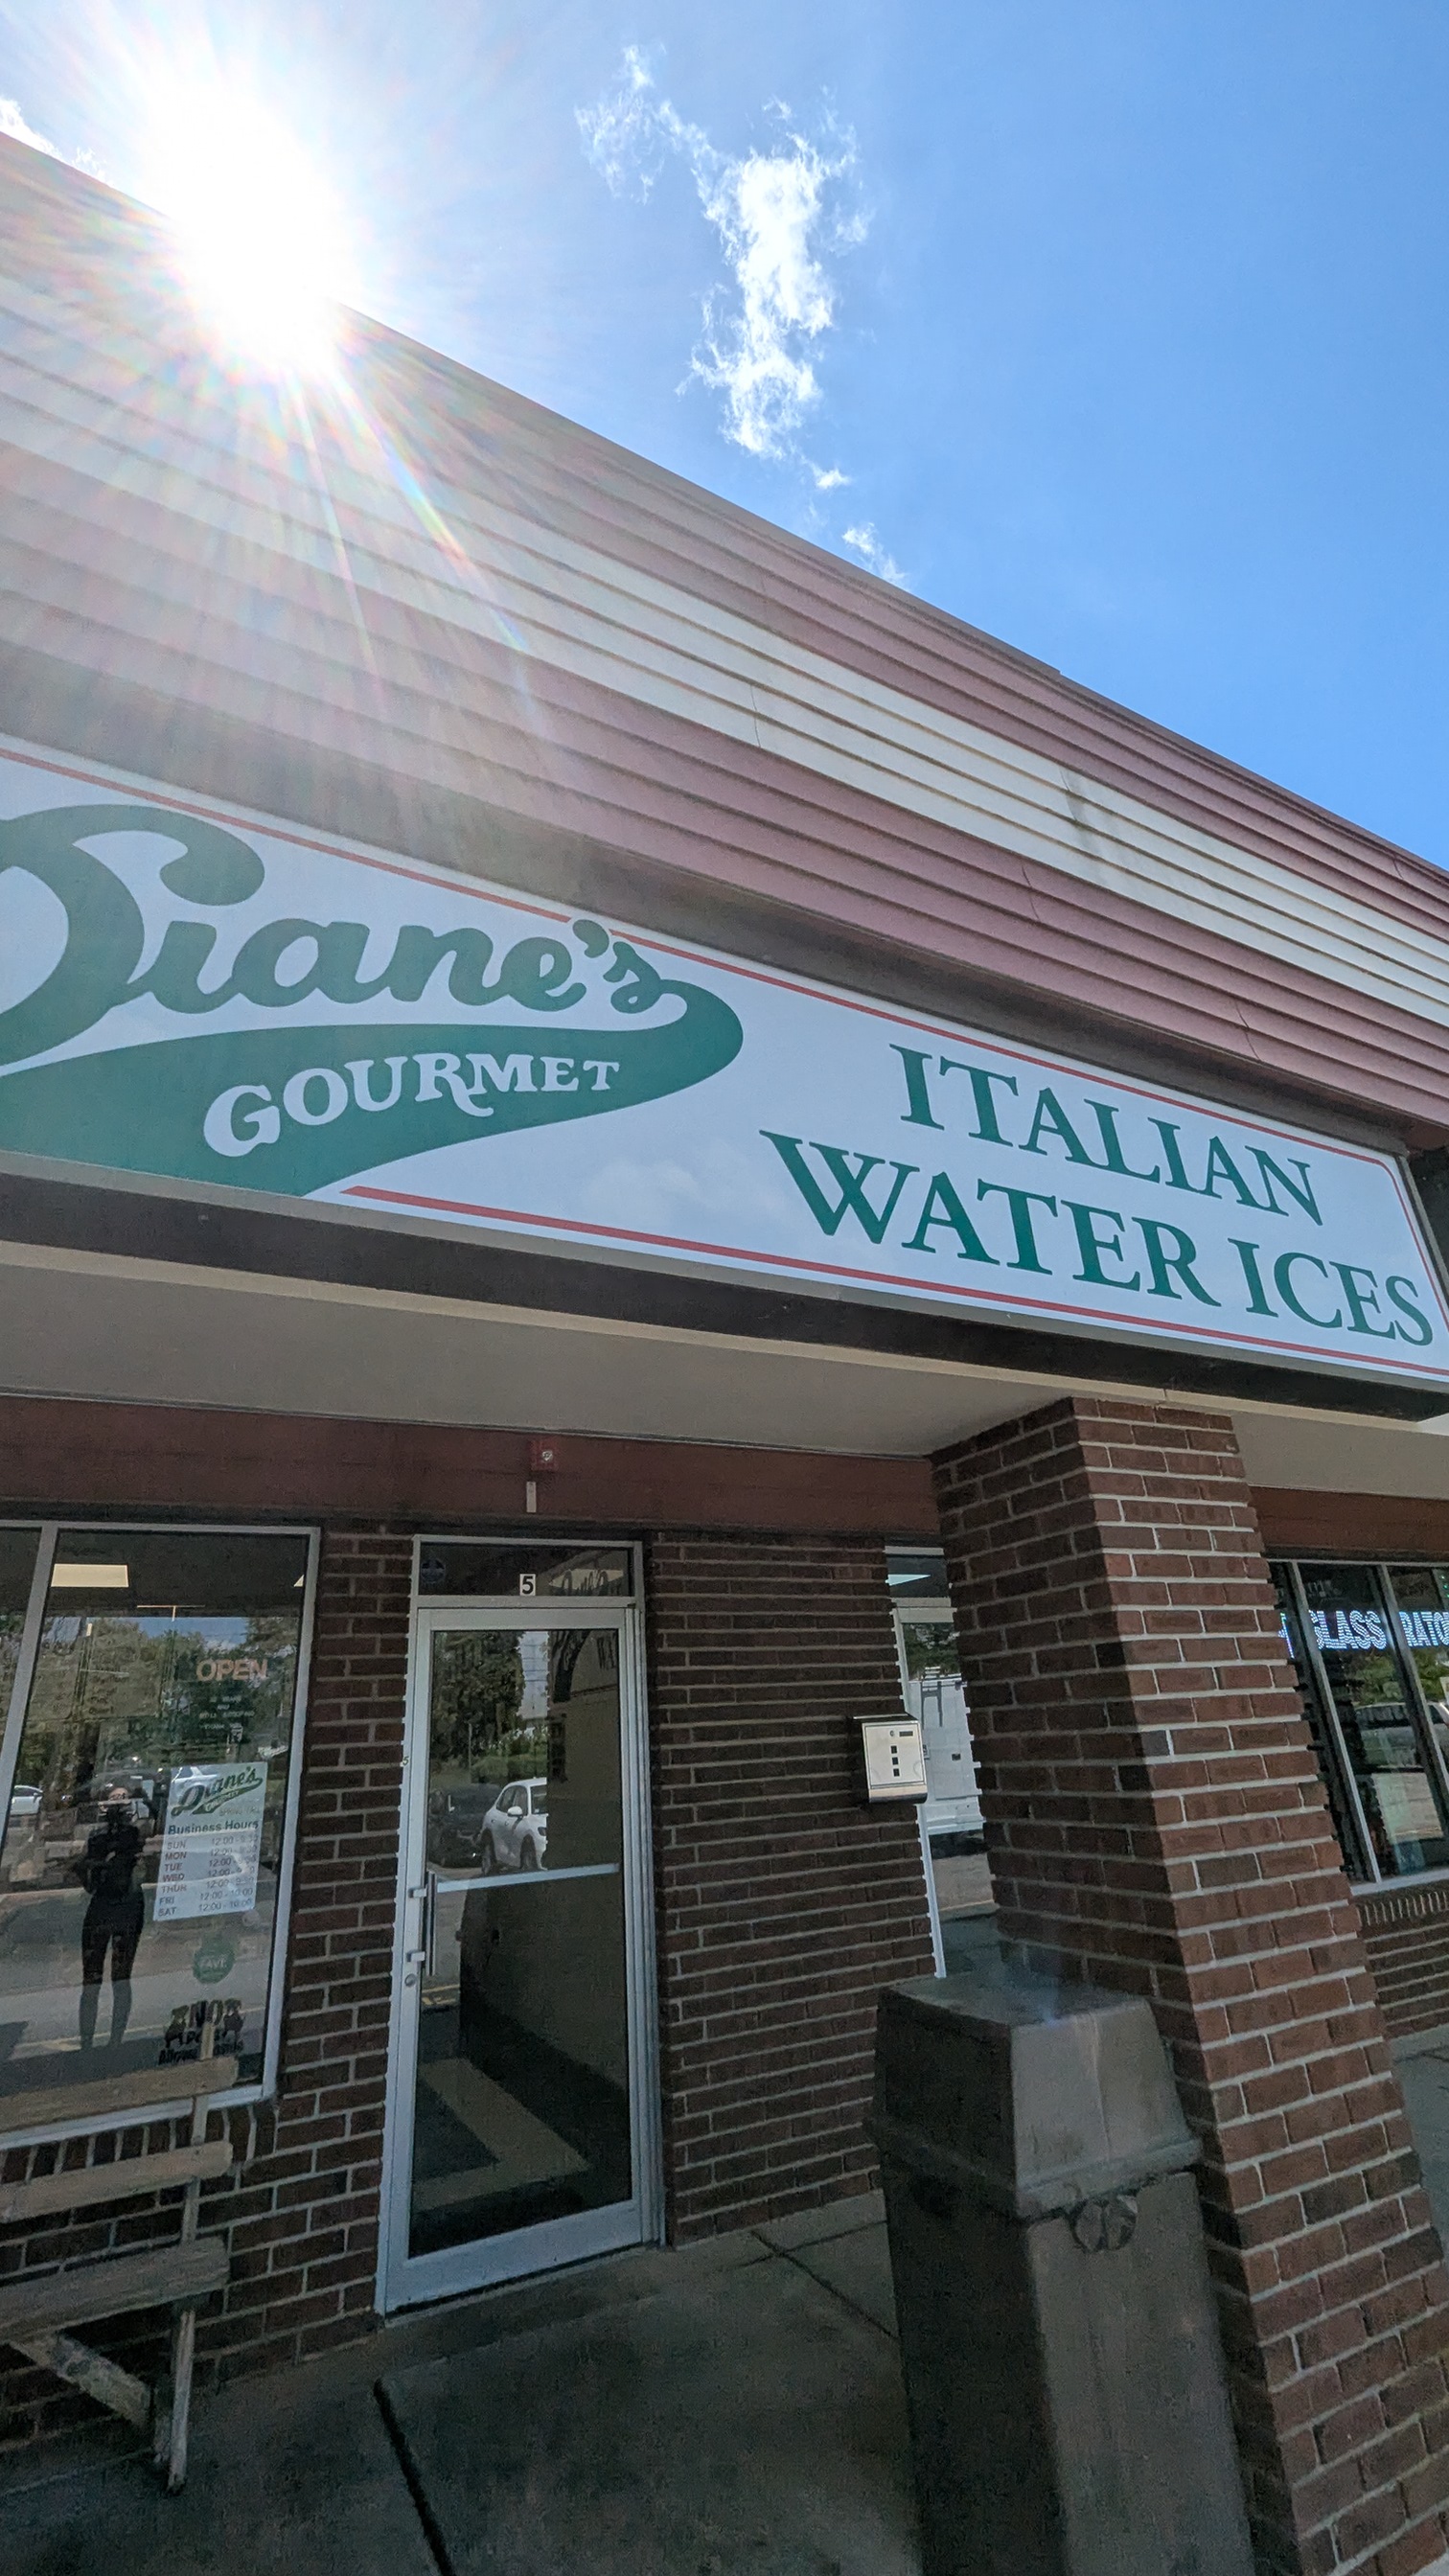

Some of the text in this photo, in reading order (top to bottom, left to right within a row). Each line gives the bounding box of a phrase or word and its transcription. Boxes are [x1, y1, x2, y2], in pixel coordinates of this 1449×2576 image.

[203, 1052, 619, 1157] GOURMET
[888, 1044, 1322, 1226] ITALIAN
[759, 1129, 1434, 1346] WATER ICES
[521, 1576, 534, 1595] 5
[196, 1658, 267, 1681] OPEN
[402, 1756, 409, 1766] 5
[168, 1819, 259, 1835] Business Hours
[165, 1852, 187, 1860] MON
[163, 1874, 185, 1882] WED
[161, 1885, 187, 1894] THUR
[159, 1897, 174, 1905] FRI
[158, 1908, 177, 1917] SAT
